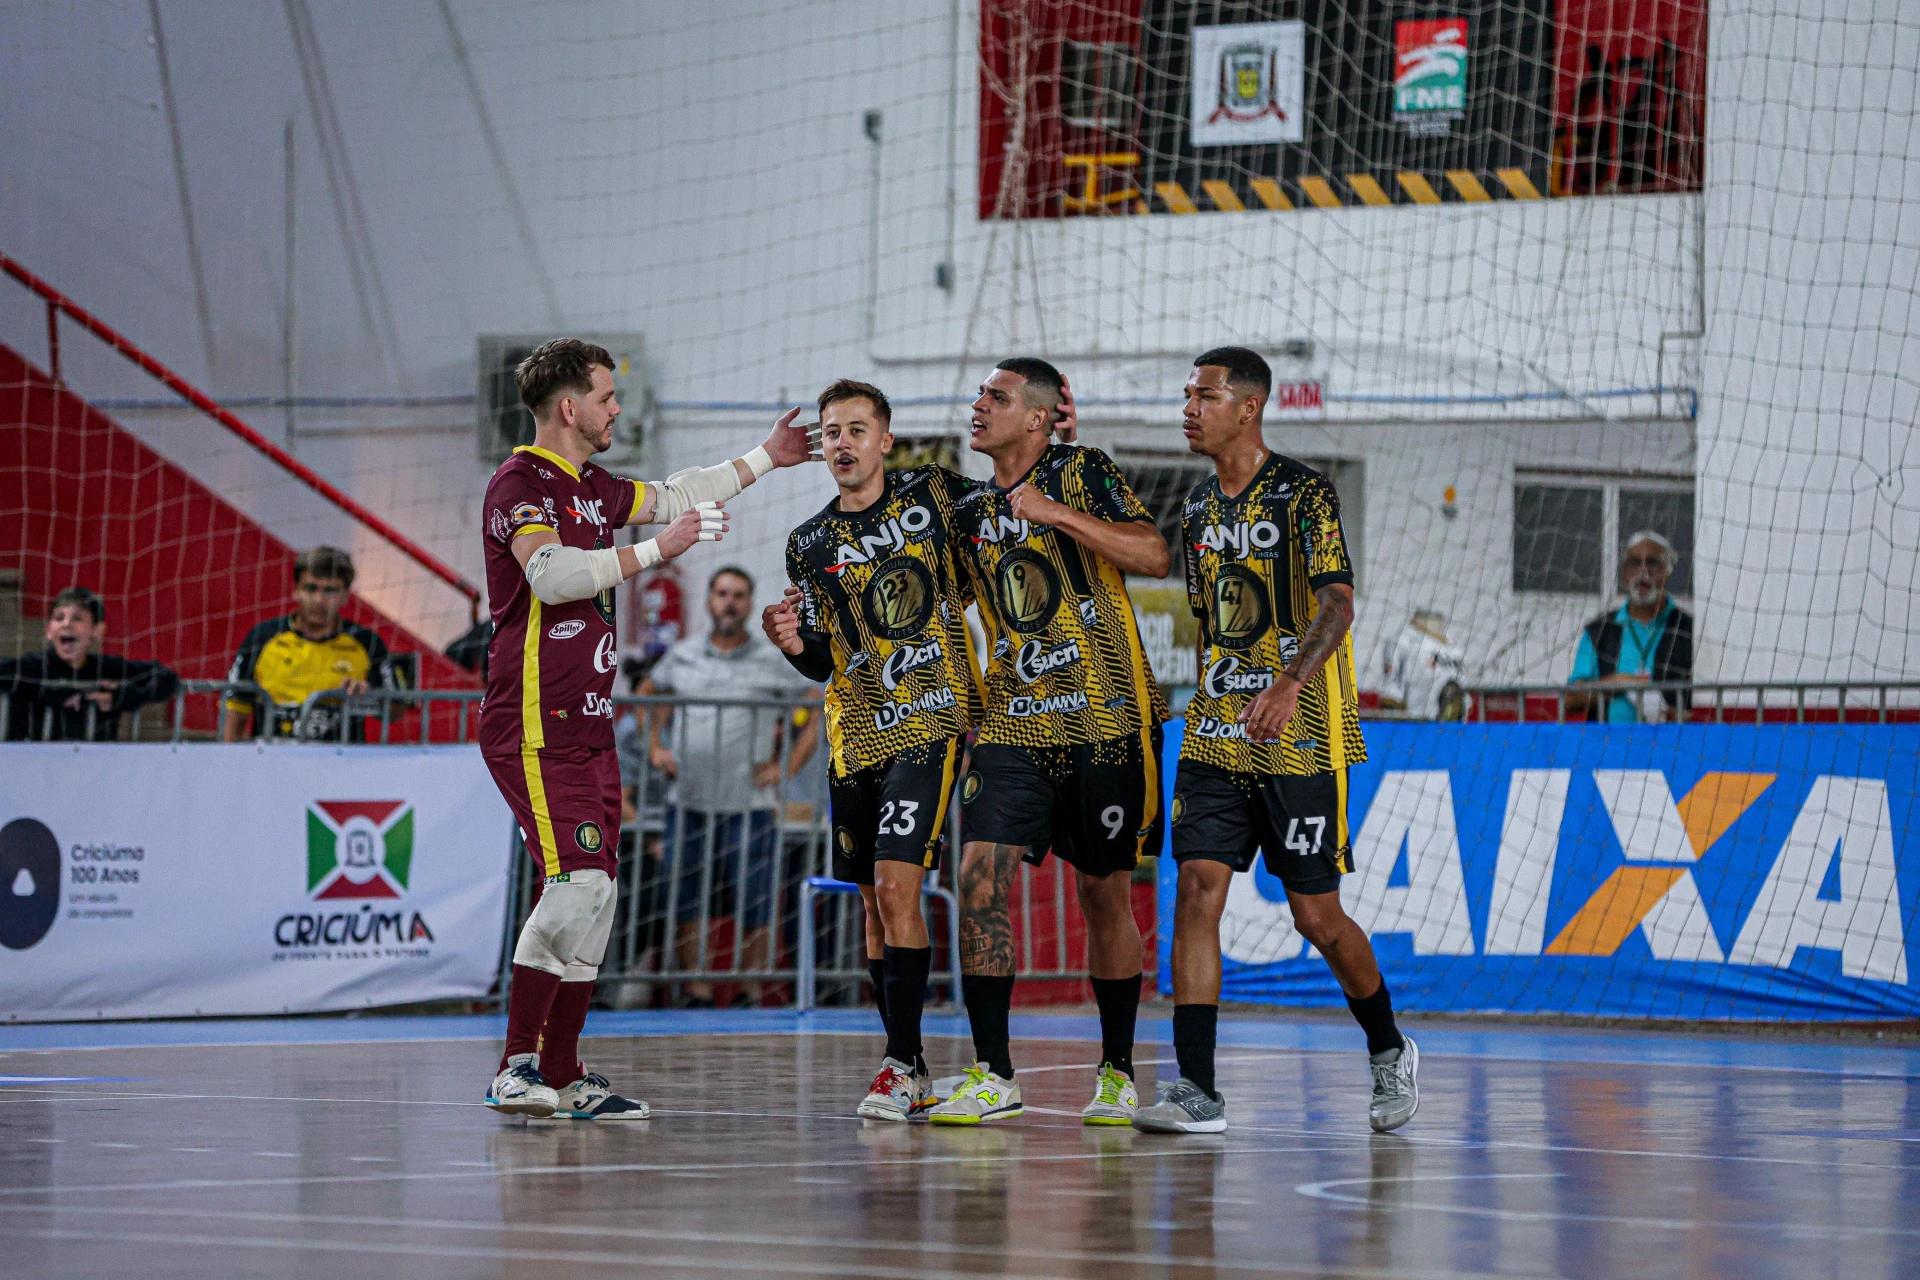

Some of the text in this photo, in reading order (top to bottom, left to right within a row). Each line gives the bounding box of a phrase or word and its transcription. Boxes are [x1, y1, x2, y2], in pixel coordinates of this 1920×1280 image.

[834, 505, 931, 577] ANJO
[973, 514, 1030, 550] ANJ
[1198, 520, 1280, 560] ANJO
[1253, 551, 1279, 559] TINTAS
[883, 570, 909, 601] 23
[1013, 564, 1026, 590] 9
[1221, 581, 1244, 605] 47
[1195, 716, 1251, 738] DOM
[877, 799, 919, 836] 23
[1101, 805, 1125, 840] 9
[1284, 815, 1326, 856] 47
[71, 843, 145, 862] Criciúma
[71, 866, 140, 884] 100 Anos
[274, 904, 435, 947] CRICIÚMA
